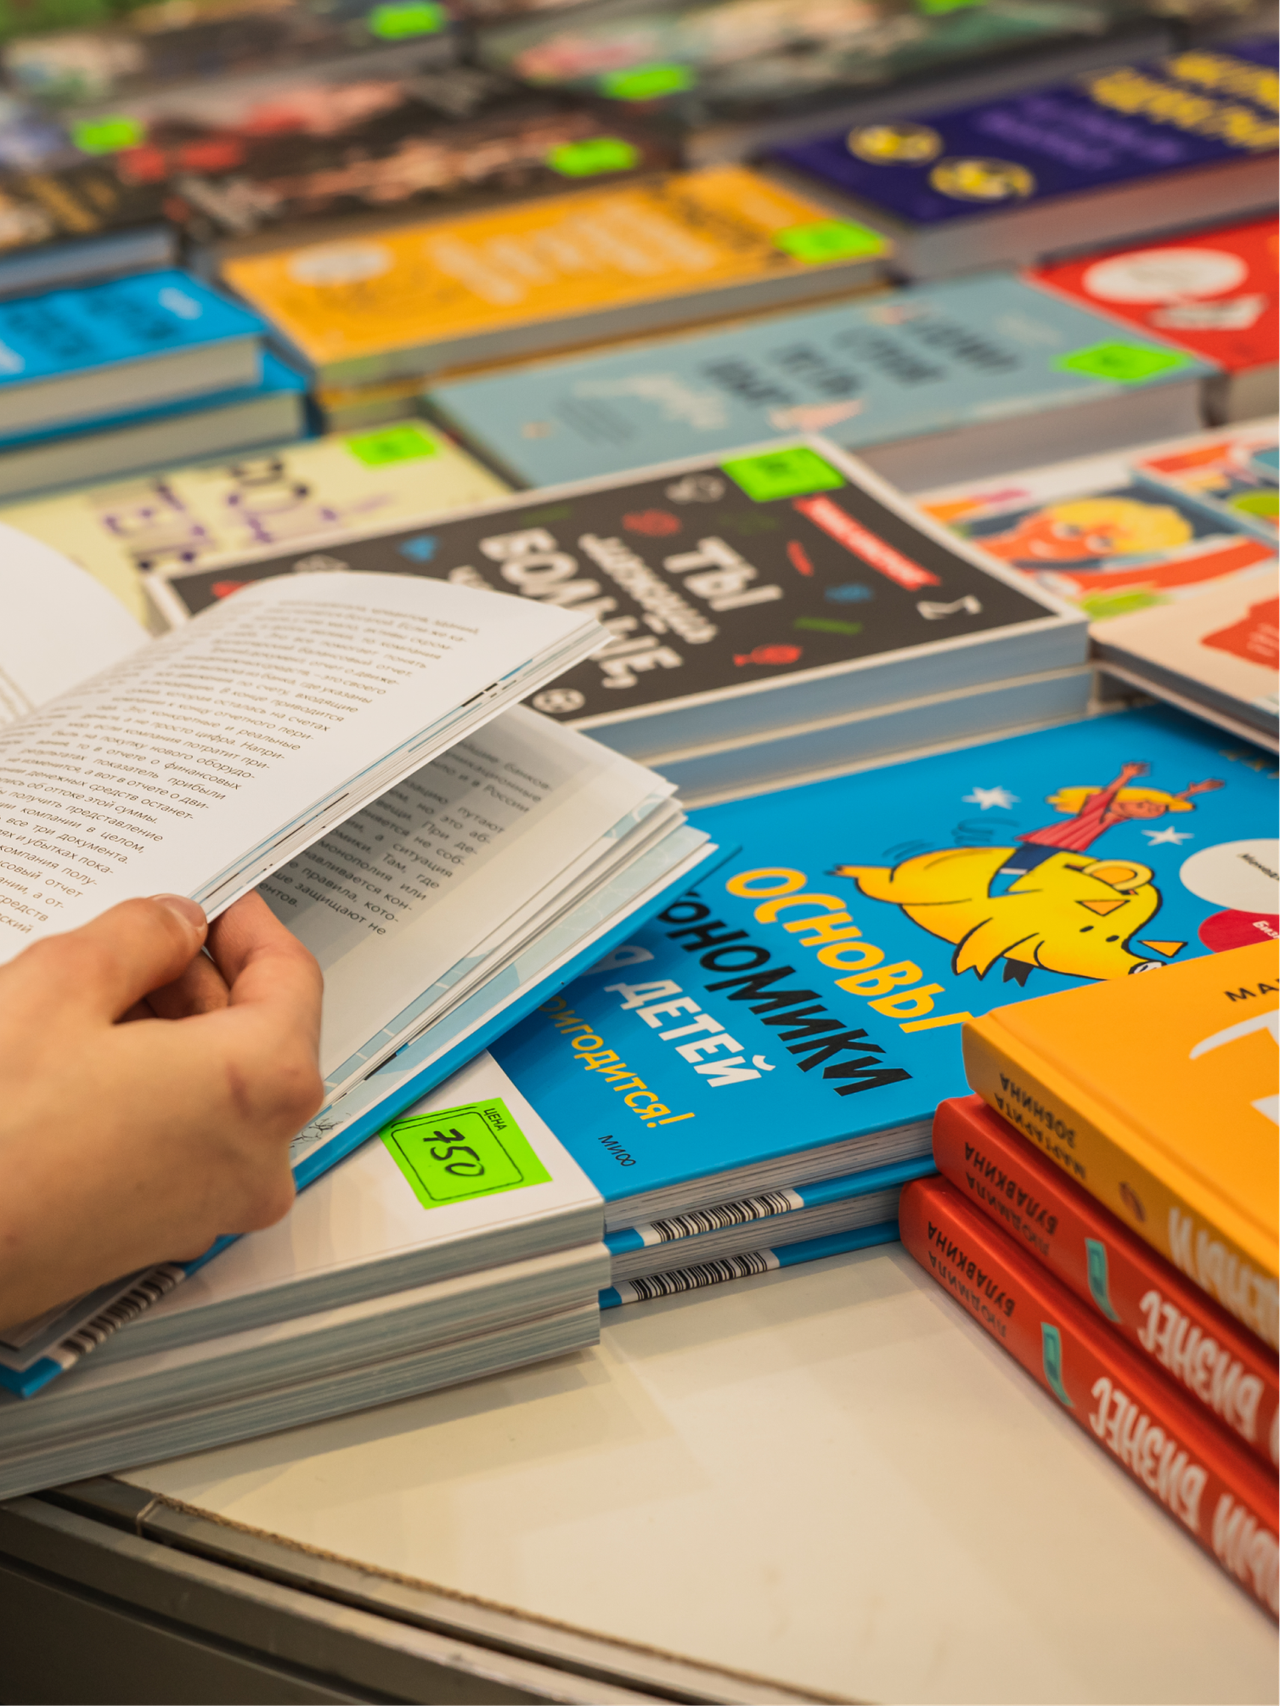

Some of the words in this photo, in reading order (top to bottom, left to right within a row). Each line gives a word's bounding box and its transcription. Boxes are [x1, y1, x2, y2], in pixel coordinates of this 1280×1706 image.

[663, 536, 783, 612] ТЫ
[270, 698, 345, 722] приводится
[294, 692, 359, 713] входящие
[213, 710, 276, 730] отчетного
[277, 726, 314, 741] пери-
[235, 729, 301, 751] реальные
[288, 716, 330, 732] счетах
[106, 747, 147, 762] отчете
[164, 761, 242, 791] финансовых
[123, 728, 181, 744] компания
[182, 741, 241, 760] потратит
[240, 756, 270, 769] при-
[150, 745, 195, 761] нового
[196, 757, 255, 779] оборудо-
[239, 740, 285, 760] Напри-
[25, 770, 89, 788] денежных
[89, 783, 139, 802] средств
[140, 798, 194, 820] останет-
[93, 758, 159, 780] показатель
[167, 776, 226, 800] прибыли
[94, 771, 119, 782] вот
[126, 779, 169, 797] отчете
[178, 795, 210, 810] дви-
[482, 783, 531, 813] России
[9, 791, 63, 809] получить
[65, 804, 164, 843] представление
[44, 786, 85, 802] оттоке
[84, 795, 116, 809] этой
[114, 803, 157, 824] суммы.
[416, 802, 435, 815] но
[439, 815, 463, 831] это
[469, 830, 492, 845] аб-
[457, 806, 506, 834] путают
[5, 817, 29, 828] все
[32, 822, 56, 837] три
[55, 832, 129, 865] документа.
[20, 807, 83, 829] компании
[100, 831, 145, 854] целом,
[421, 820, 451, 841] При
[454, 840, 479, 856] де-
[22, 836, 79, 861] убытках
[78, 855, 114, 875] пока-
[318, 839, 394, 883] монополия
[399, 882, 428, 902] или
[382, 852, 408, 874] Там,
[416, 873, 441, 890] где
[392, 842, 453, 879] ситуация
[413, 836, 433, 850] не
[435, 847, 466, 867] соб-
[45, 878, 85, 899] отчет
[61, 866, 98, 886] полу-
[301, 867, 358, 904] правила,
[363, 901, 400, 923] кото-
[45, 896, 65, 910] от-
[294, 882, 368, 924] защищают
[367, 921, 387, 936] не
[383, 892, 413, 912] кон-
[726, 867, 976, 1034] ОСНОВЫ
[657, 891, 913, 1098] ОНОМИКИ
[603, 979, 777, 1088] ДЕТЕЙ
[483, 1107, 508, 1132] ЦЕНА
[422, 1127, 486, 1178] 750
[964, 1141, 1059, 1236] БУЛАВКИНА
[965, 1171, 1050, 1257] ЛЮДМИЛА
[927, 1220, 1016, 1318] БУЛАВКИНА
[928, 1250, 1007, 1338] ЛЮДМИЛА
[1136, 1289, 1265, 1443] БИЗНЕС
[1087, 1376, 1209, 1538] БИЗНЕС
